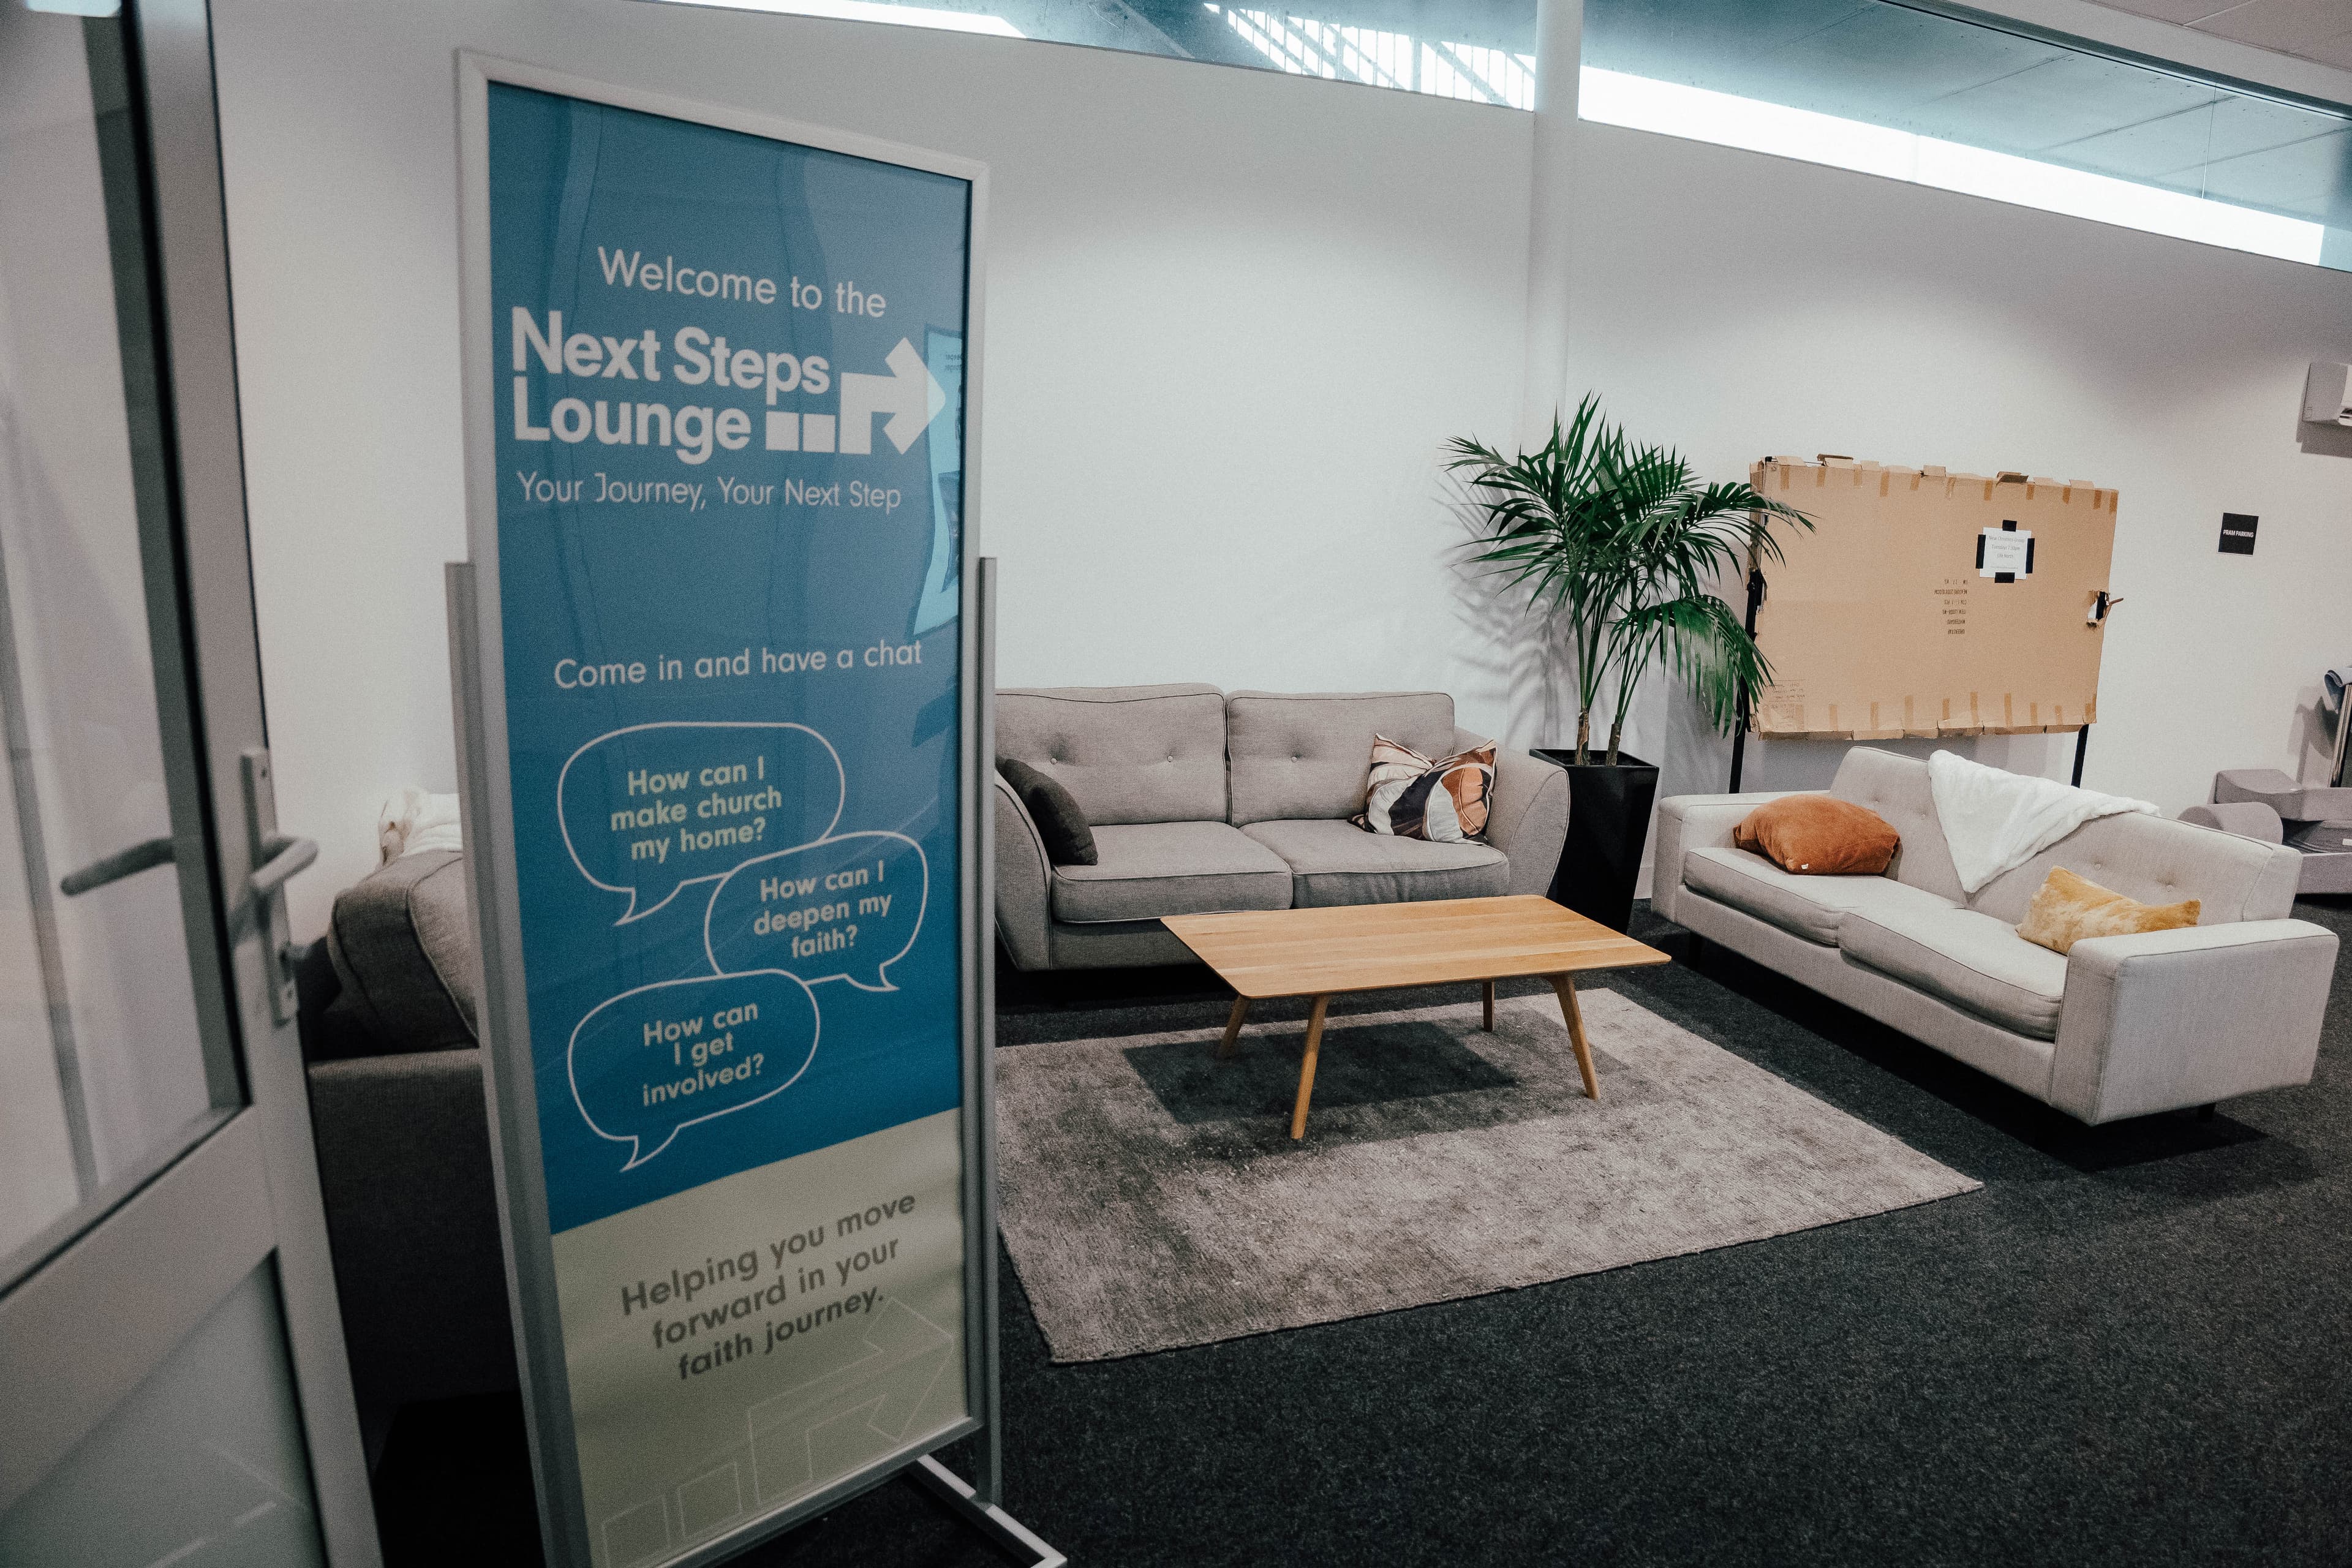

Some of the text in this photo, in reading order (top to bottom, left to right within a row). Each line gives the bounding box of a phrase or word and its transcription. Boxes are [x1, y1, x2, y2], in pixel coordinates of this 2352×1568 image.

[598, 246, 886, 317] Welcome to the
[513, 307, 829, 405] Next Steps
[514, 376, 751, 466] Lounge
[518, 472, 900, 513] Your Journey, Your Next Step
[553, 639, 922, 689] Come in and have a chat
[628, 756, 765, 797] How can I
[611, 786, 782, 831] make church
[631, 816, 766, 864] my home?
[760, 860, 884, 902] How can I
[753, 894, 892, 936] deepen my
[791, 924, 858, 959] faith?
[643, 1003, 758, 1047] How can
[674, 1031, 734, 1068] I get
[643, 1052, 765, 1107] involved?
[621, 1195, 916, 1316] Helping you move
[653, 1238, 899, 1349] forward in your
[678, 1287, 884, 1381] faith journey.
